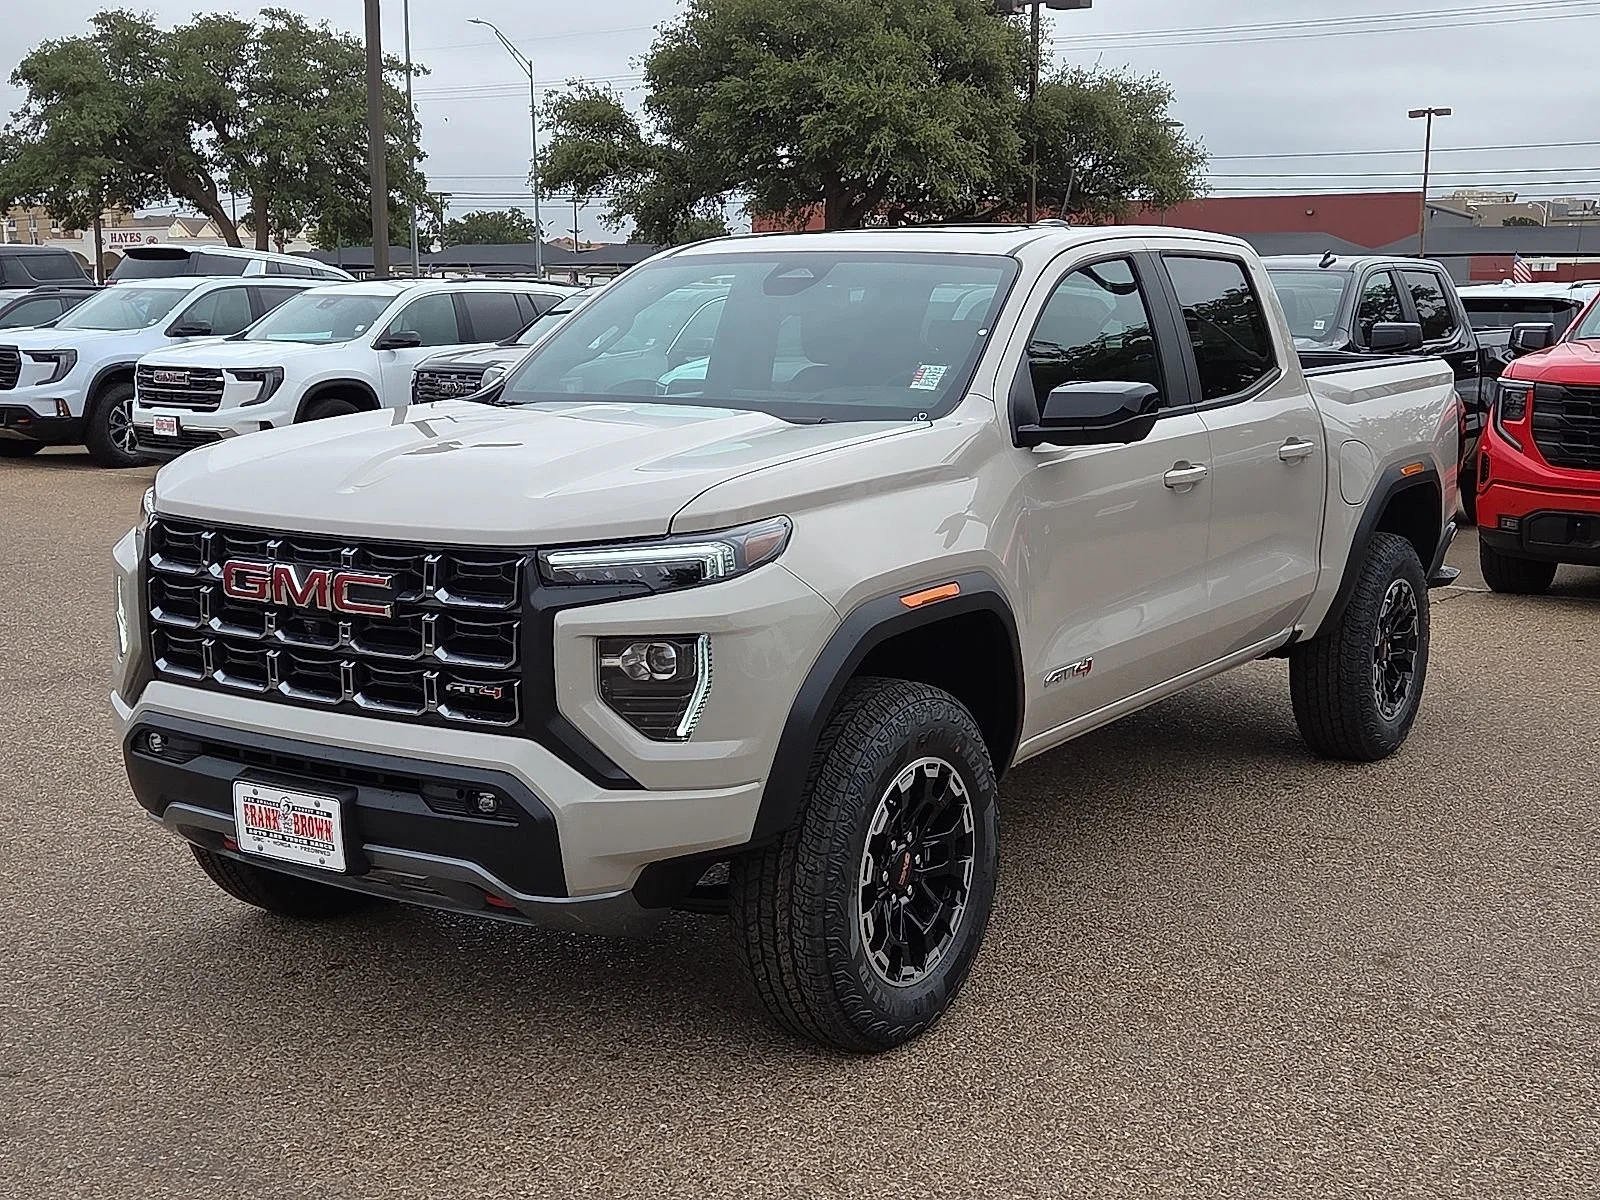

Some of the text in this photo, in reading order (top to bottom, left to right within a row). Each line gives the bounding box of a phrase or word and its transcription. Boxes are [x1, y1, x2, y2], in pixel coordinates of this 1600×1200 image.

[110, 232, 142, 243] HAYES
[223, 559, 393, 618] GMC
[1043, 656, 1094, 688] AT4
[445, 682, 502, 699] AT4
[916, 727, 990, 793] GOOYEAR
[243, 803, 281, 832] FRANK
[292, 812, 334, 843] BROWN
[285, 836, 308, 846] TRUCK
